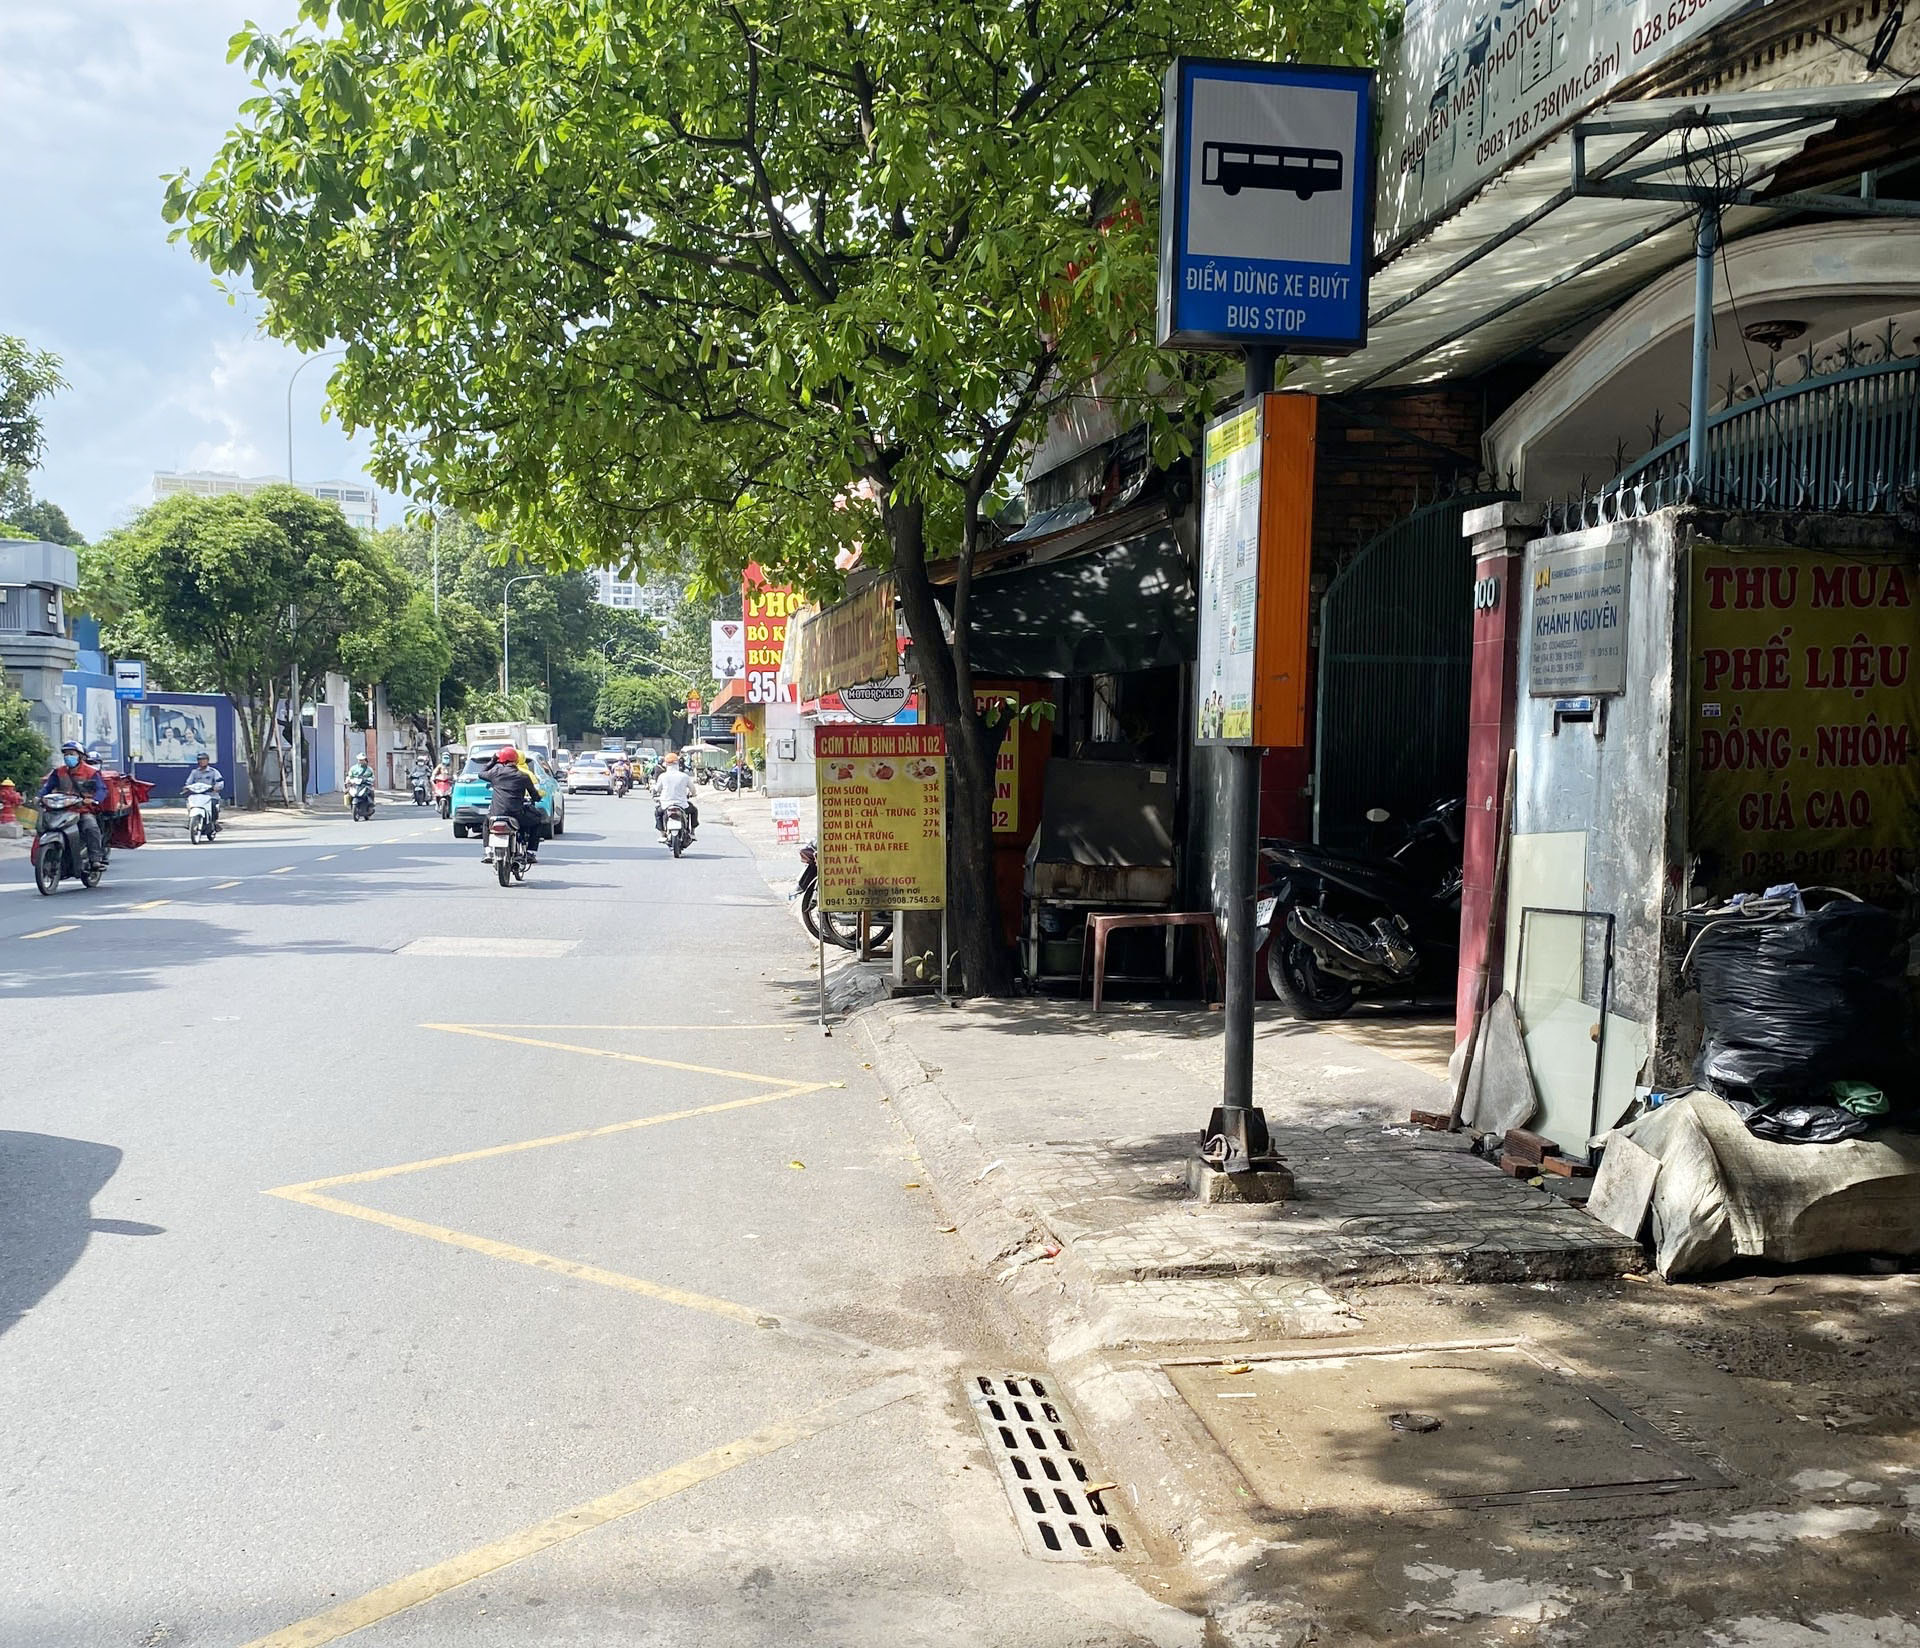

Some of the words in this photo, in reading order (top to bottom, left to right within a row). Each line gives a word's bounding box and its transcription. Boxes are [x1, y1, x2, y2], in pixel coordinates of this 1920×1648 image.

[1186, 260, 1228, 293] ĐIỂM
[1233, 266, 1279, 296] DỪNG
[1284, 274, 1304, 298] XE
[1309, 271, 1350, 300] BUÝT
[1227, 305, 1260, 329] BUS
[1264, 307, 1306, 332] STOP
[1474, 577, 1496, 609] 100
[1703, 565, 1799, 610] THU
[1810, 564, 1912, 609] MUA
[1536, 608, 1571, 636] KHÁNH
[1573, 601, 1617, 632] NGUYÊN
[747, 622, 769, 642] BÒ
[748, 645, 783, 666] BÚN
[1703, 626, 1793, 691] PHẾ
[1804, 632, 1910, 699] LIỆU
[848, 688, 904, 702] MOTORCYCLES
[820, 736, 844, 754] CƠM
[847, 730, 869, 754] TẤM
[871, 733, 896, 754] BÌNH
[898, 732, 919, 753] DÂN
[922, 735, 940, 753] 102
[1701, 705, 1792, 771] ĐỒNG
[1816, 712, 1909, 768] NHÔM
[822, 786, 842, 795] CƠM
[822, 798, 842, 806] CƠM
[844, 798, 862, 806] HEO
[863, 797, 887, 806] QUAY
[1738, 780, 1796, 831] GIÁ
[823, 809, 842, 818] CƠM
[844, 807, 853, 817] BÌ
[823, 820, 842, 829] CƠM
[844, 819, 854, 829] BÌ
[823, 832, 842, 841] CƠM
[823, 844, 848, 853] CANH
[888, 842, 909, 851] FREE
[824, 867, 844, 875] CAM
[846, 888, 866, 896] Giao
